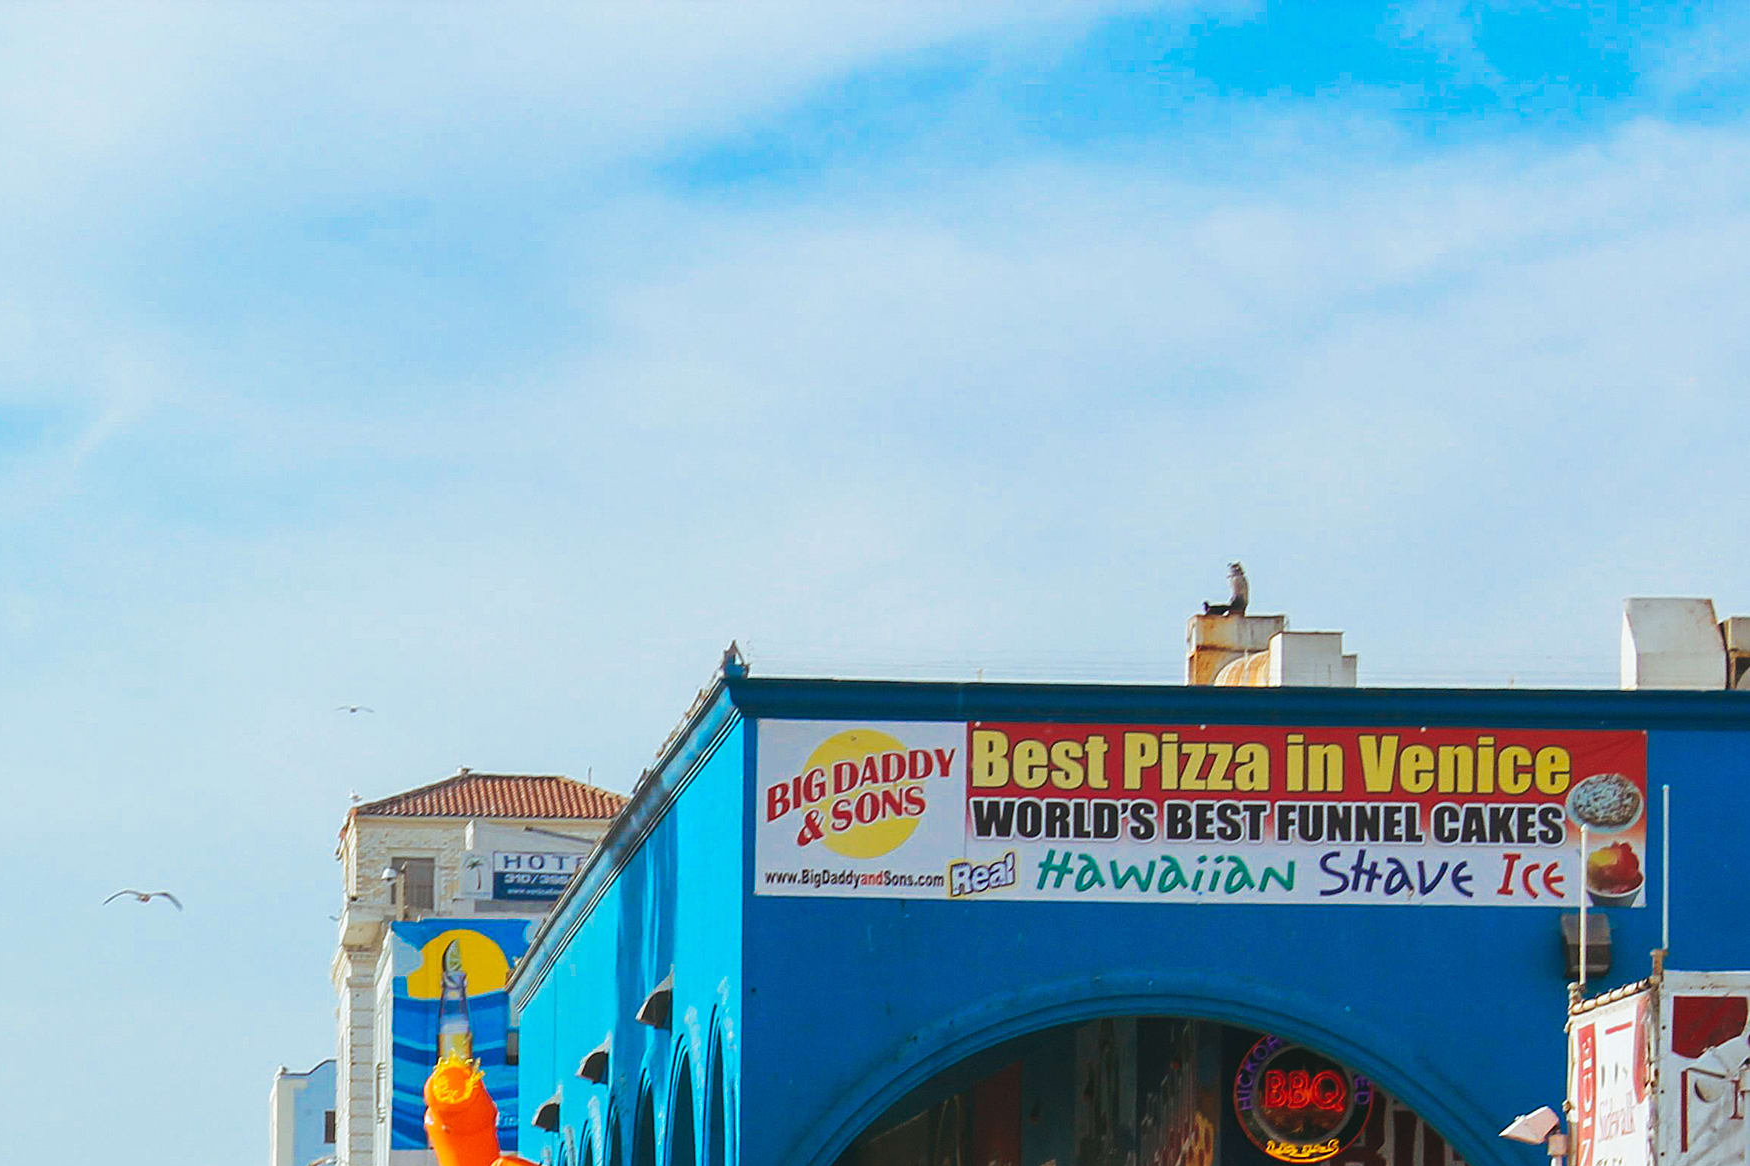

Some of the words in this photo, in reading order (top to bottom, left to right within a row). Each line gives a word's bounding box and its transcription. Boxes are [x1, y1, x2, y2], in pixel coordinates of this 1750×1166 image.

[971, 729, 1109, 789] Best
[1123, 731, 1271, 792] Pizza
[1286, 733, 1344, 792] in
[1358, 734, 1571, 795] Venice
[766, 767, 827, 823] BIG
[833, 747, 956, 795] DADDY
[796, 809, 824, 847] &
[831, 786, 926, 832] SONS
[971, 800, 1156, 840] WORLD'S
[1166, 801, 1267, 842] BEST
[1276, 802, 1424, 843] FUNNEL
[1433, 804, 1563, 845] CAKES
[764, 868, 945, 888] www.BigDaddyandSons.com
[951, 853, 1015, 897] Real
[1265, 1069, 1346, 1112] BBQ
